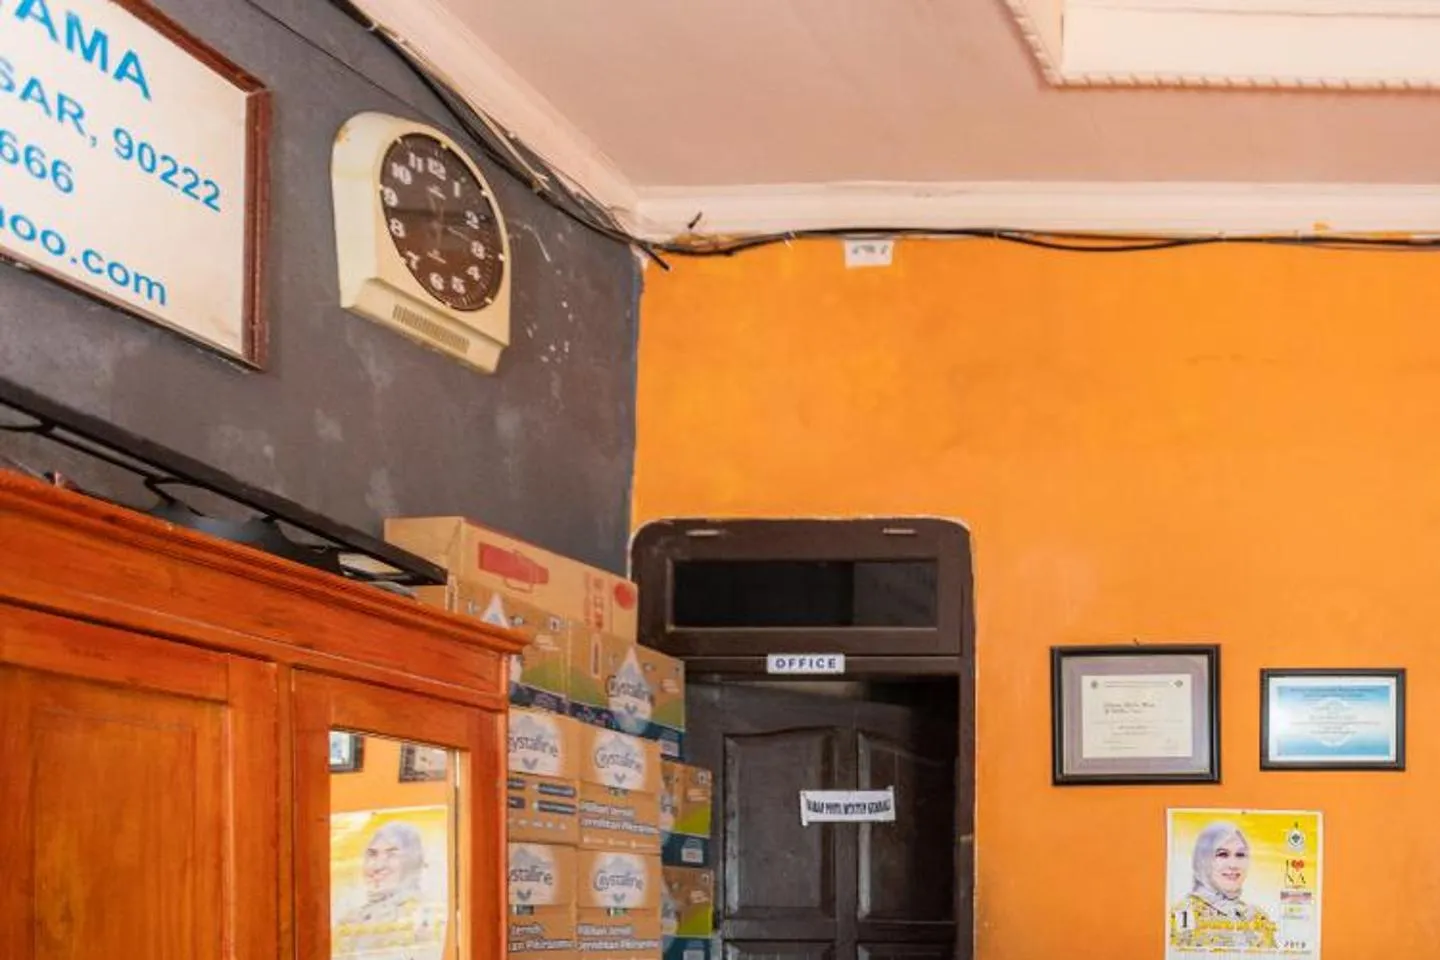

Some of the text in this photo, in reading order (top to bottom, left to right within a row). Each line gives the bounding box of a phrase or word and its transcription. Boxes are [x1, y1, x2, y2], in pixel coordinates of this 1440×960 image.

[14, 0, 152, 102] AMA
[112, 126, 222, 213] 90222
[0, 204, 168, 306] oo.com
[775, 657, 837, 669] OFFICE
